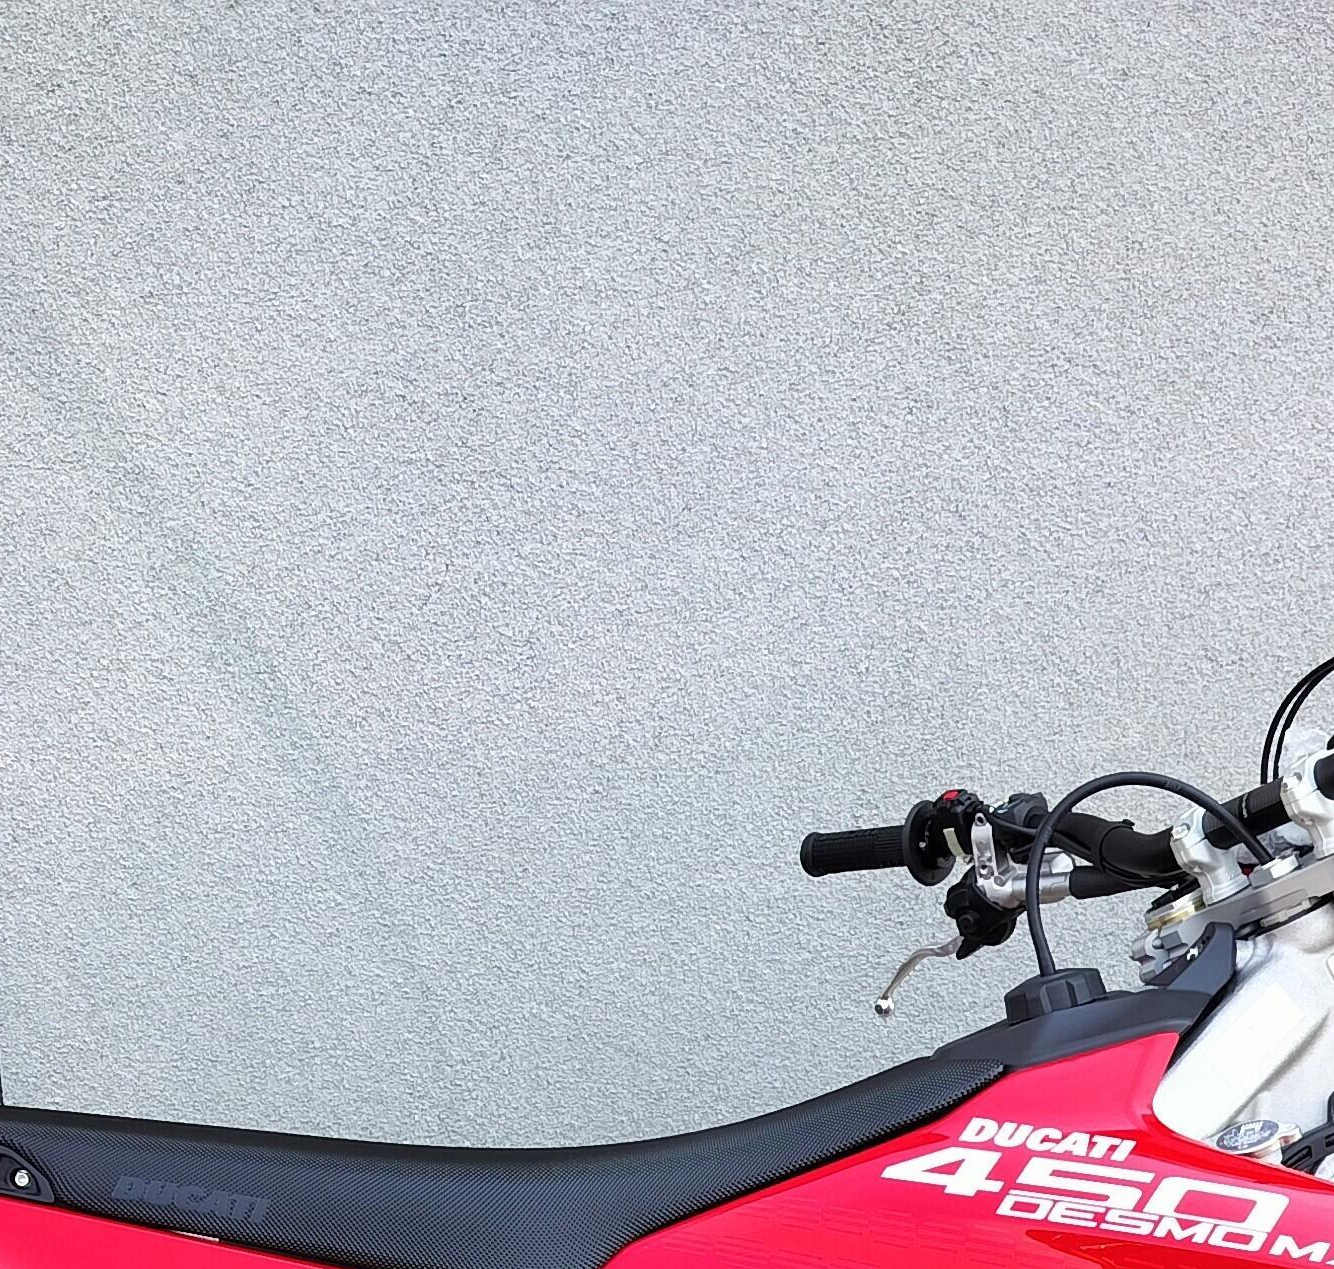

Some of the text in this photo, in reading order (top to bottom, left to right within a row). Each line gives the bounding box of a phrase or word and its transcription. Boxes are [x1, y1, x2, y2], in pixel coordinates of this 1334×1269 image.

[958, 1117, 1137, 1162] DUCATI
[111, 1175, 267, 1224] DUCATI
[880, 1146, 1290, 1233] 450
[996, 1193, 1269, 1252] DESMO
